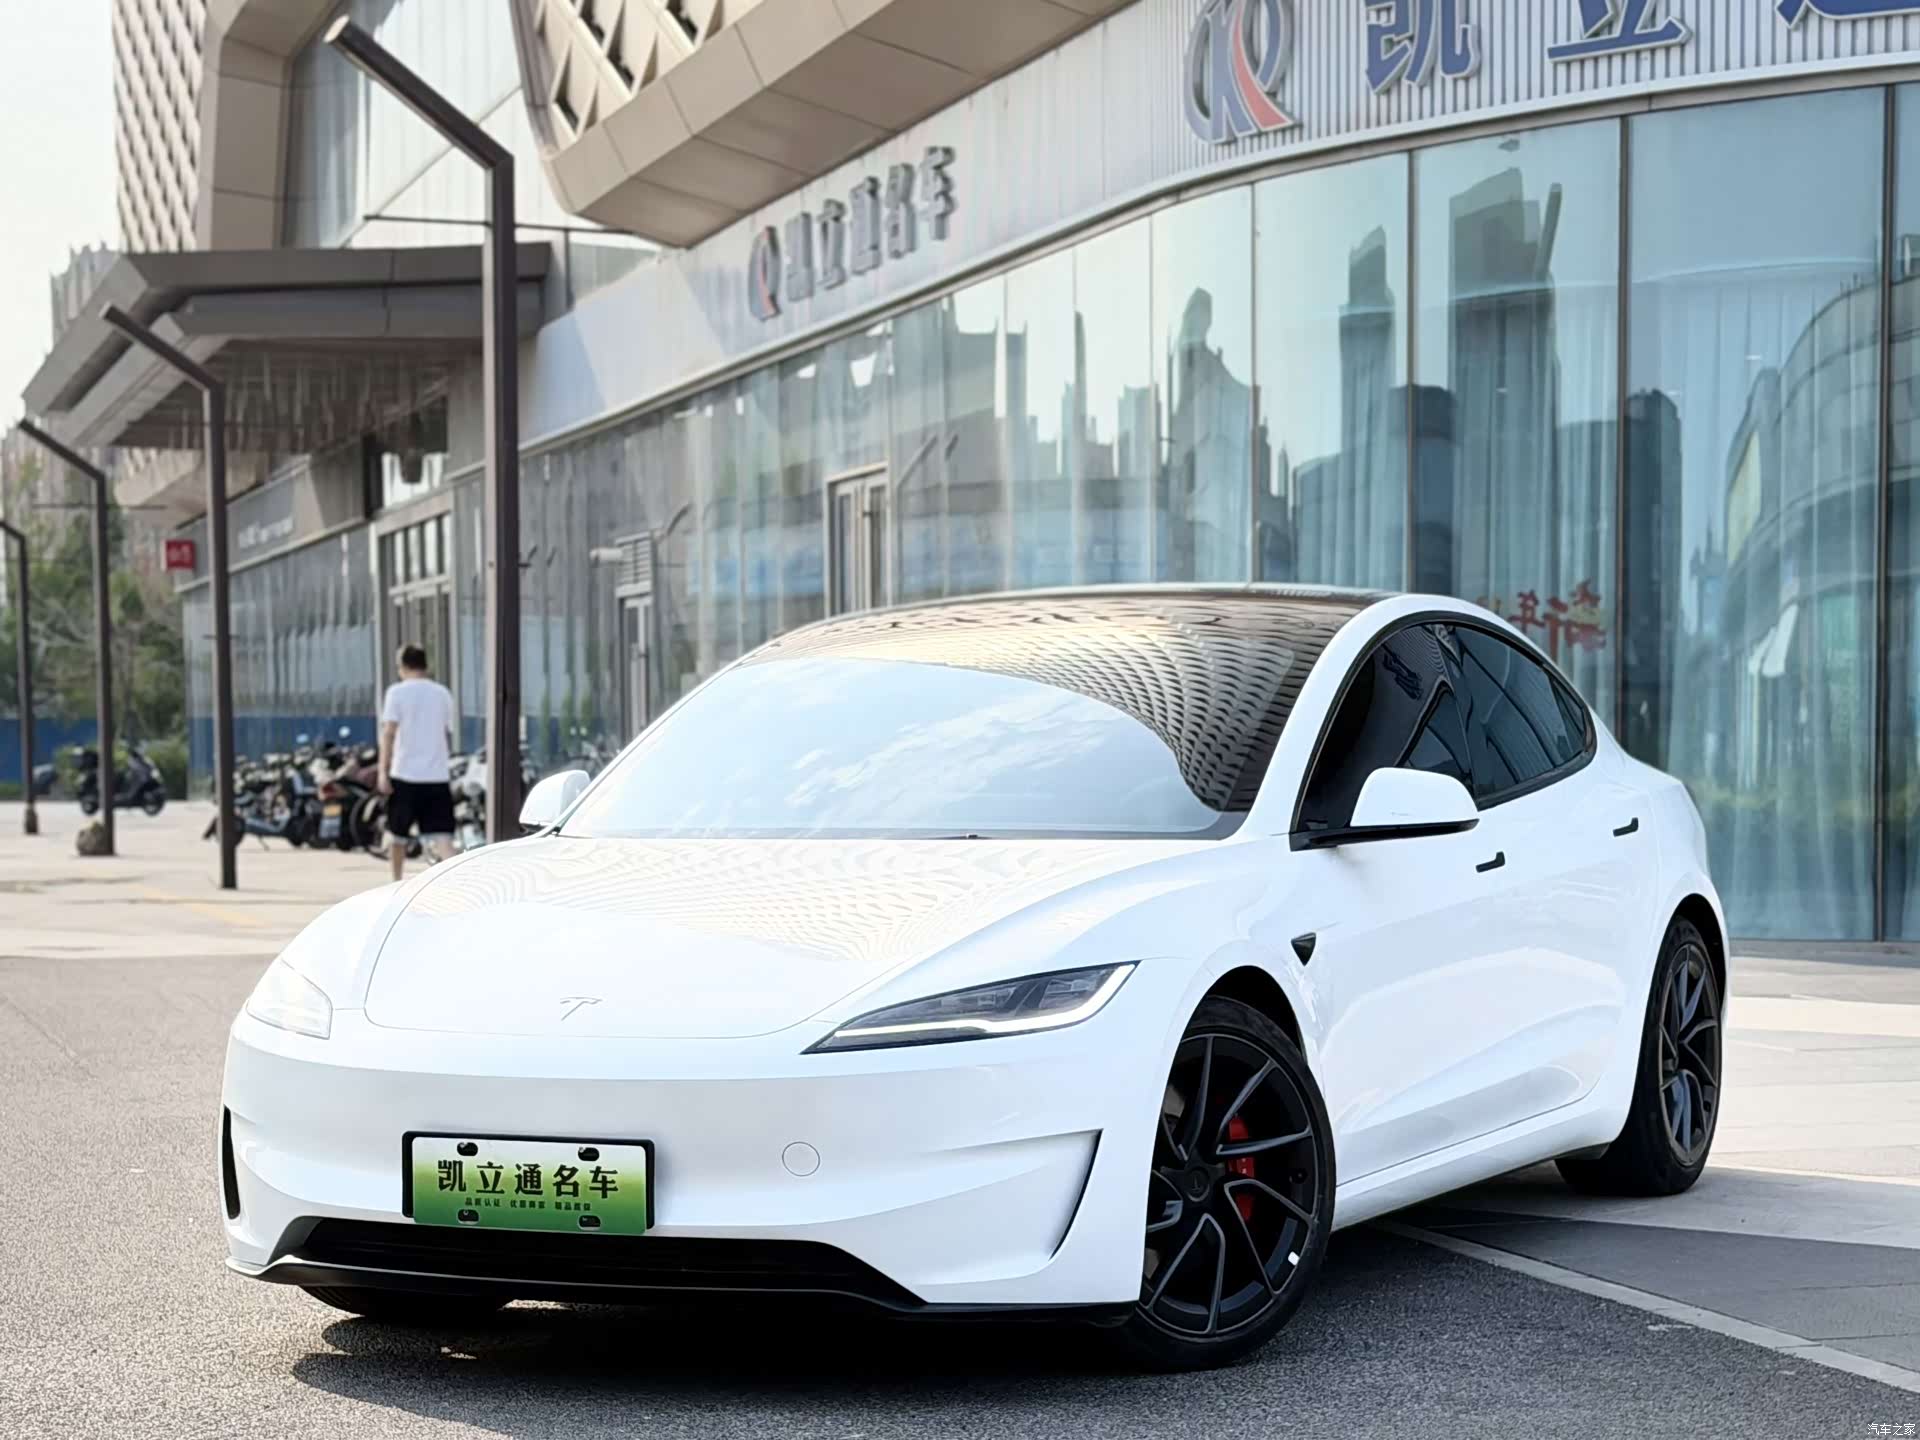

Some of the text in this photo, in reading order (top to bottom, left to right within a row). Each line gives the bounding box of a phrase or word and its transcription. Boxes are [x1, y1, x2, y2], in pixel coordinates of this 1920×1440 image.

[437, 1159, 619, 1199] 凯立通名车
